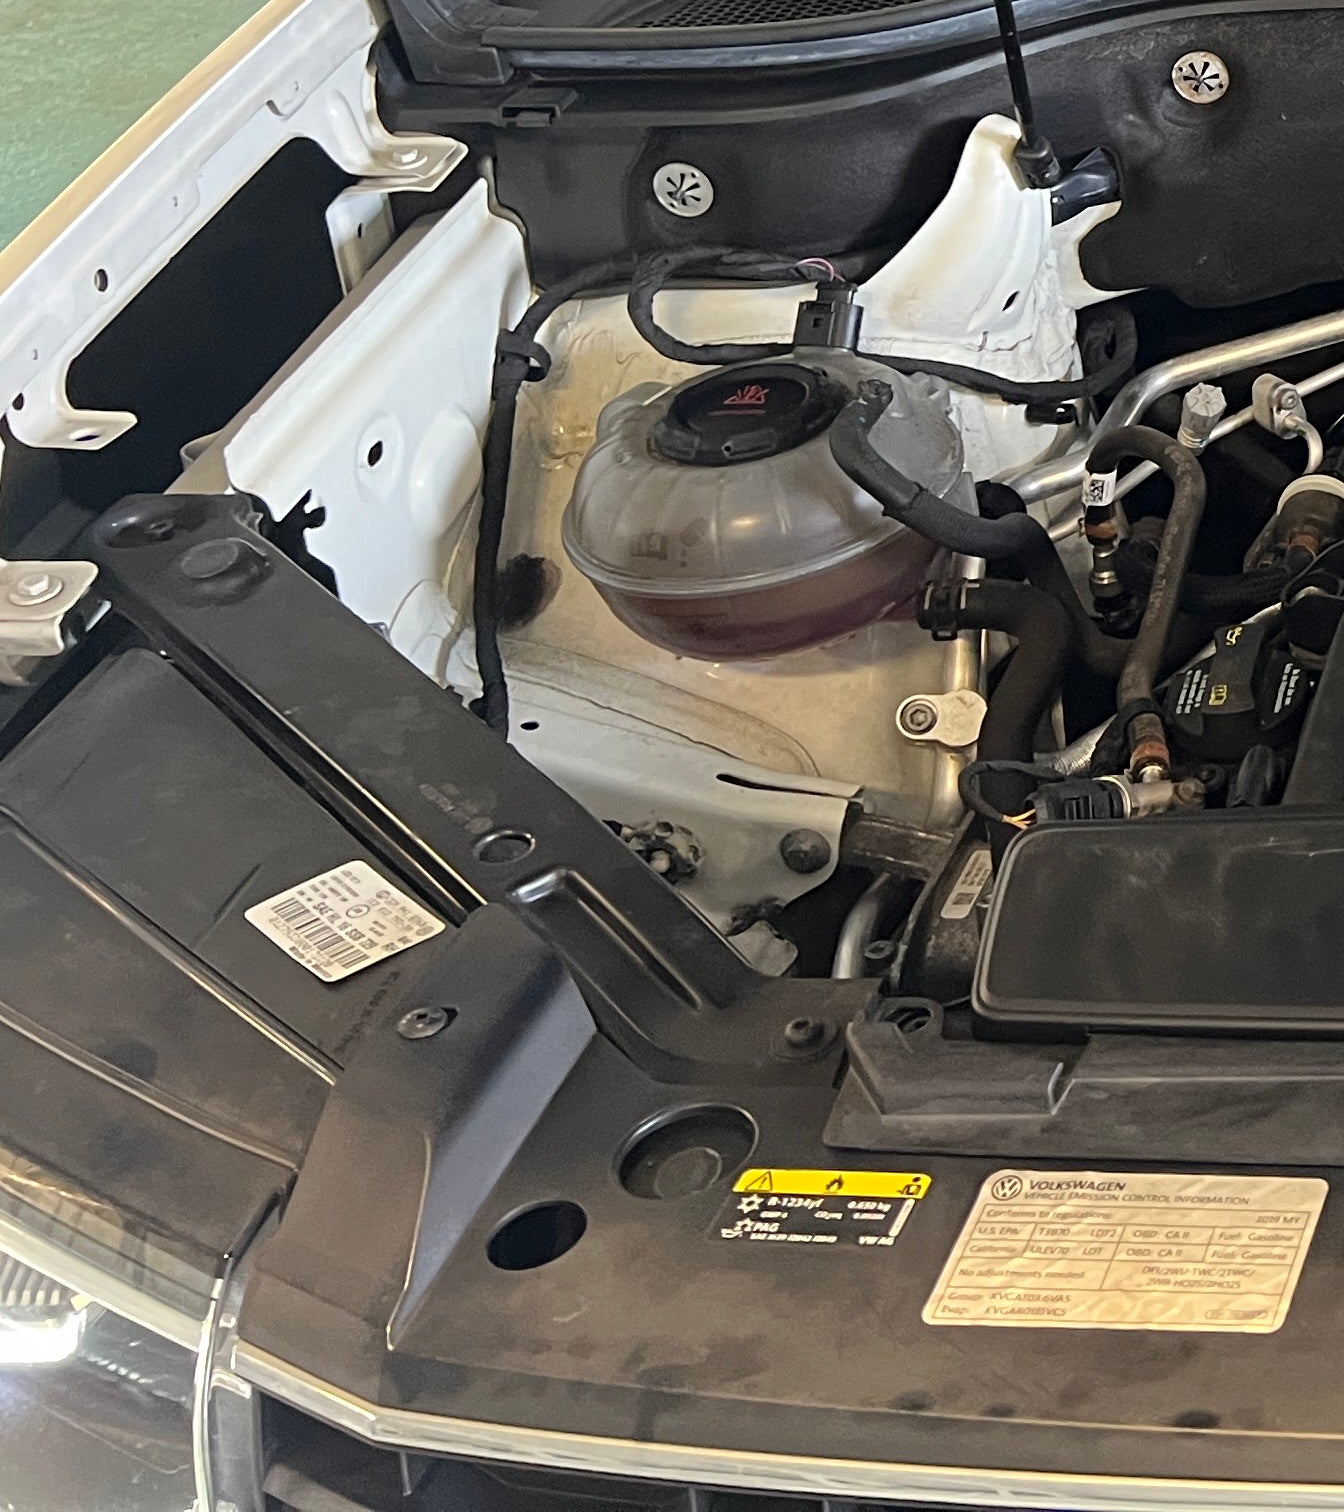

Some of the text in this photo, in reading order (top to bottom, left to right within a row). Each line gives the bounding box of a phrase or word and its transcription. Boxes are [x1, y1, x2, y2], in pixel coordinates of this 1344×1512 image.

[1029, 1180, 1127, 1192] VOLKSWAGEN
[1024, 1191, 1250, 1205] VEHICLE EMISSION CONTROL INFORMATION
[751, 1221, 781, 1233] PAG
[1247, 1232, 1295, 1242] Gasoline
[1157, 1248, 1174, 1258] CA
[958, 1268, 973, 1277] No
